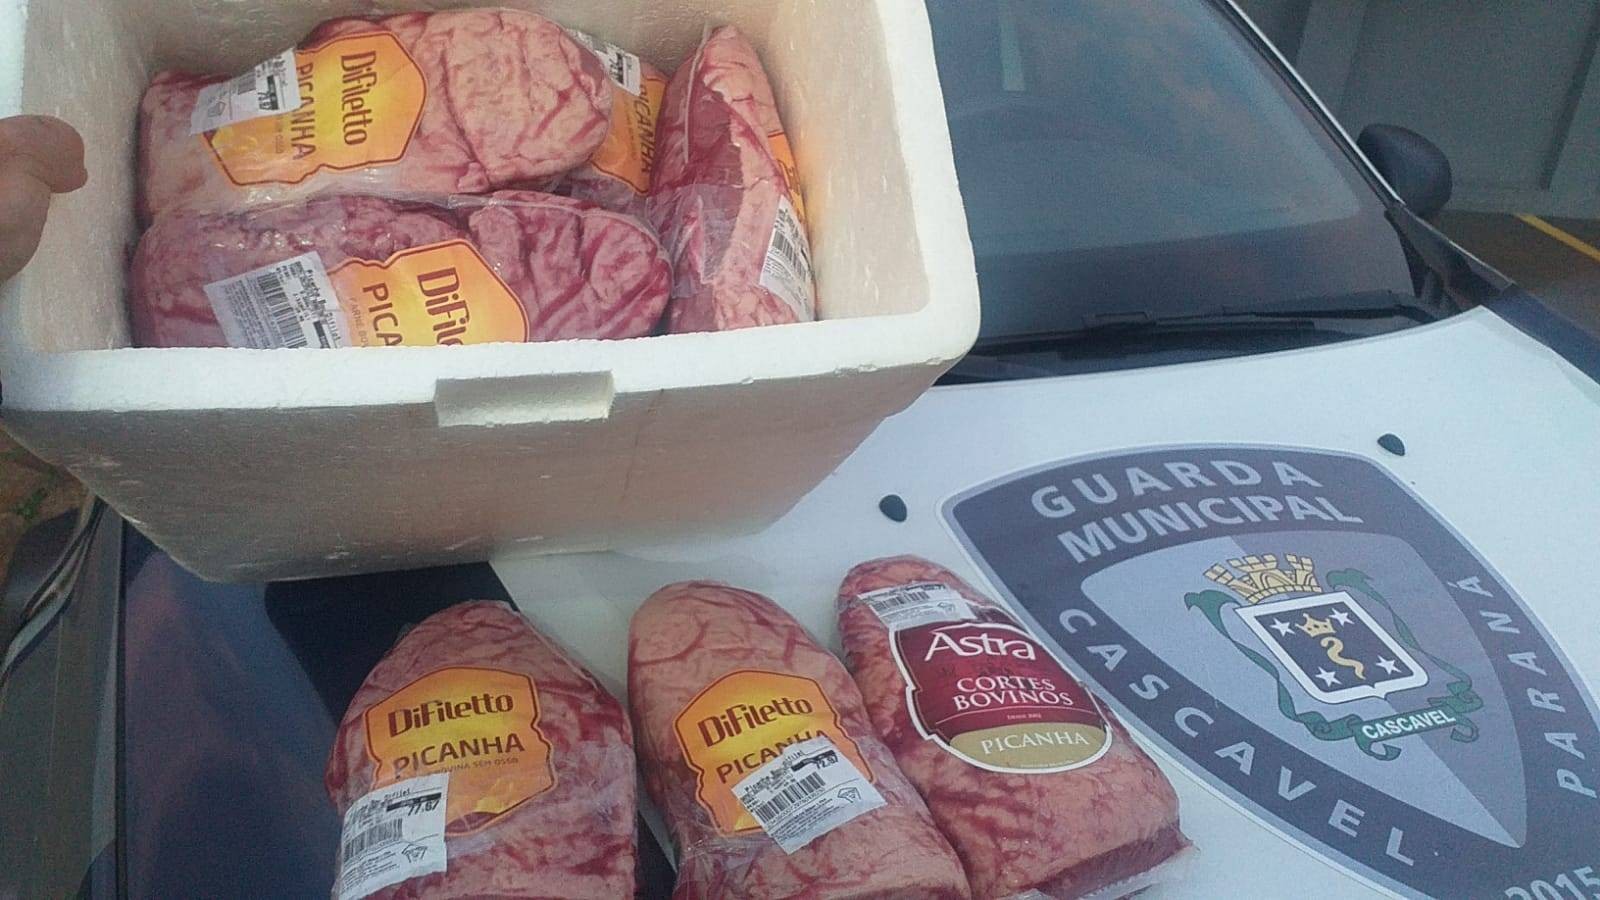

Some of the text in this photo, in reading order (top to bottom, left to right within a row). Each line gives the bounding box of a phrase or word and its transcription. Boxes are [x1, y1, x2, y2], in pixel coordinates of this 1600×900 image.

[340, 50, 377, 146] DiFiletto
[1031, 459, 1324, 520] GUARDA
[1057, 494, 1364, 564] MUNICIPAL
[924, 631, 1036, 662] Astra
[952, 690, 1074, 712] BOVINOS
[955, 675, 1056, 695] CORTES
[387, 692, 515, 738] DiFiletto
[697, 696, 814, 748] DiFiletto
[1059, 608, 1415, 867] CASCAVEL
[1362, 709, 1457, 739] CASCAVEL
[392, 732, 526, 779] PICANHA
[980, 731, 1090, 755] PICANHA
